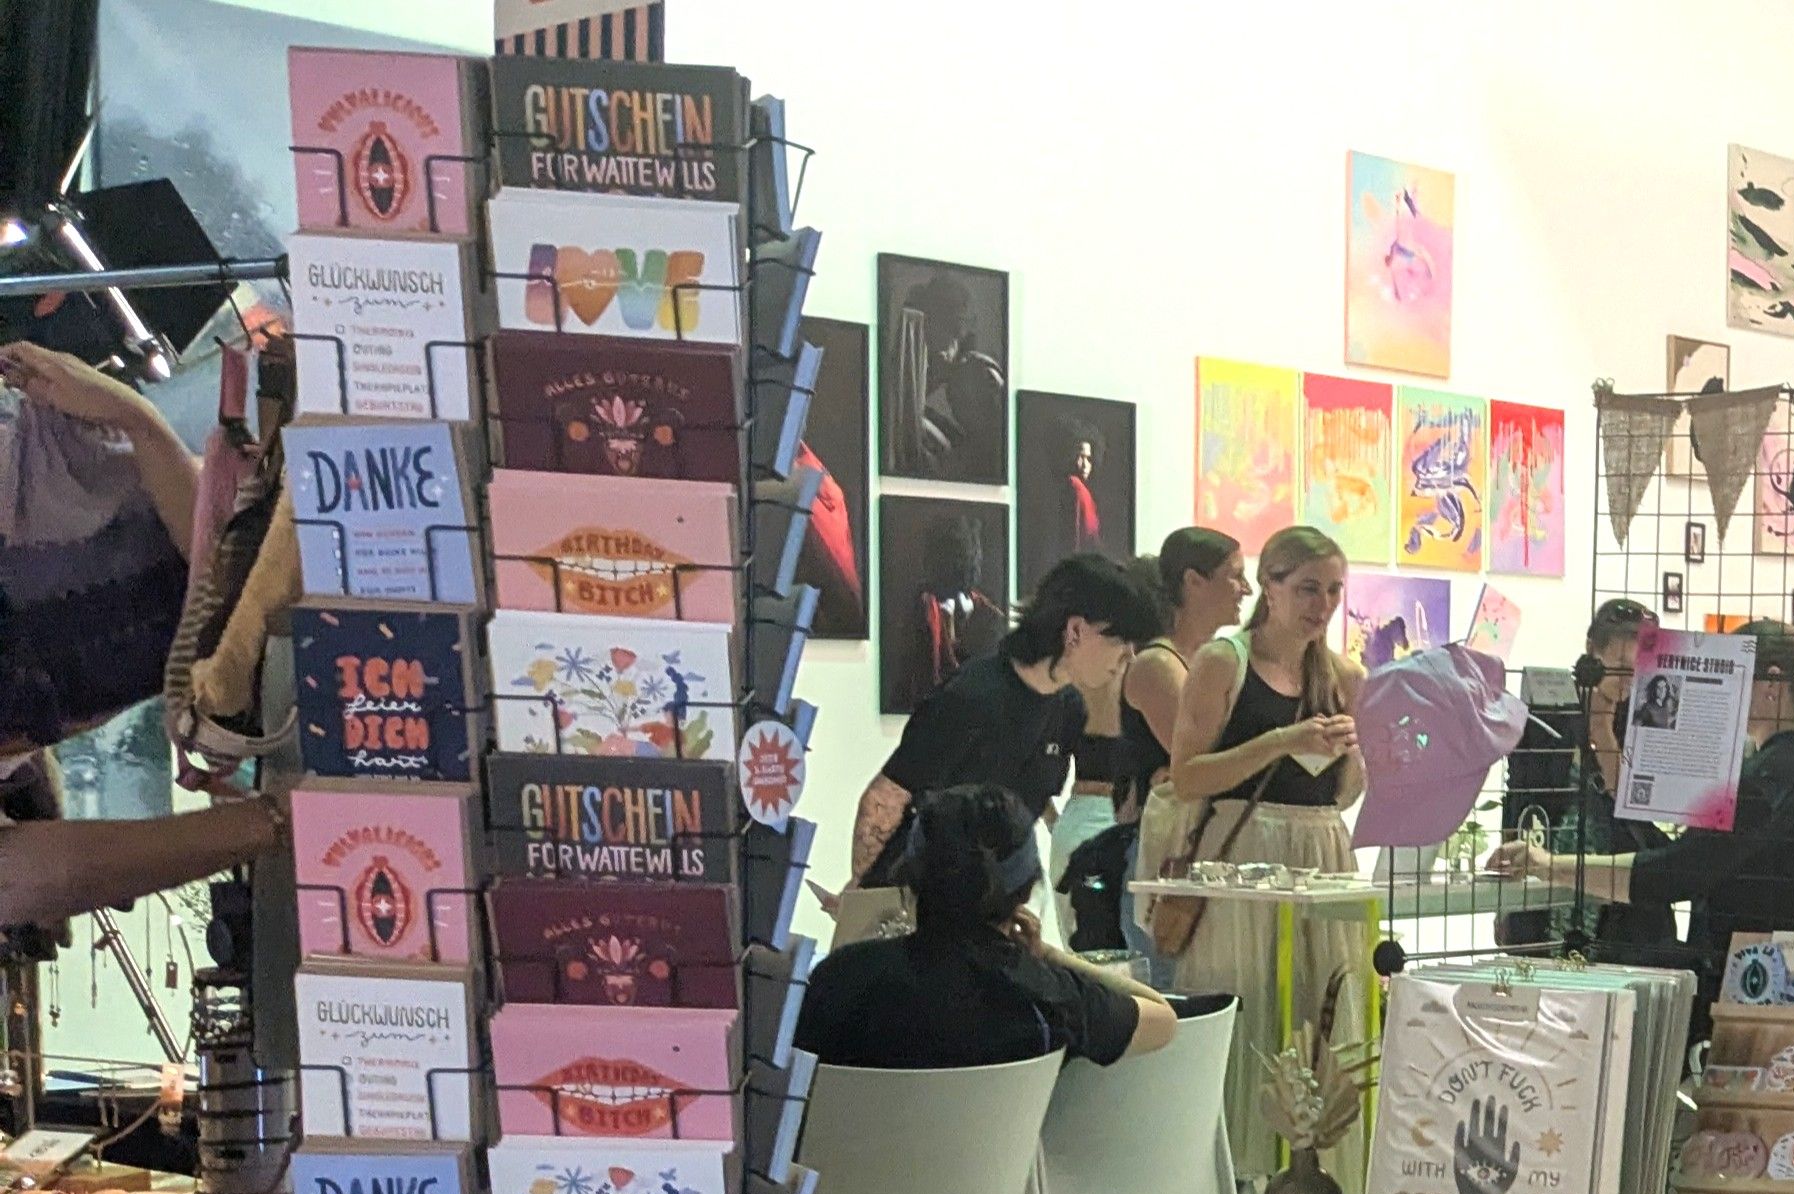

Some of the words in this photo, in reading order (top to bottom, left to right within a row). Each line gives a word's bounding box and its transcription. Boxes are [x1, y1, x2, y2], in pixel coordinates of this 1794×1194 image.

[524, 83, 714, 156] GUTSCHEIN
[307, 446, 439, 514] DANKE
[579, 582, 654, 606] BITCH
[335, 655, 425, 699] ICH
[344, 715, 430, 750] DICH
[521, 783, 700, 845] GUTSCHEIN
[1499, 1062, 1542, 1113] FUCK
[1402, 1160, 1445, 1178] WITH
